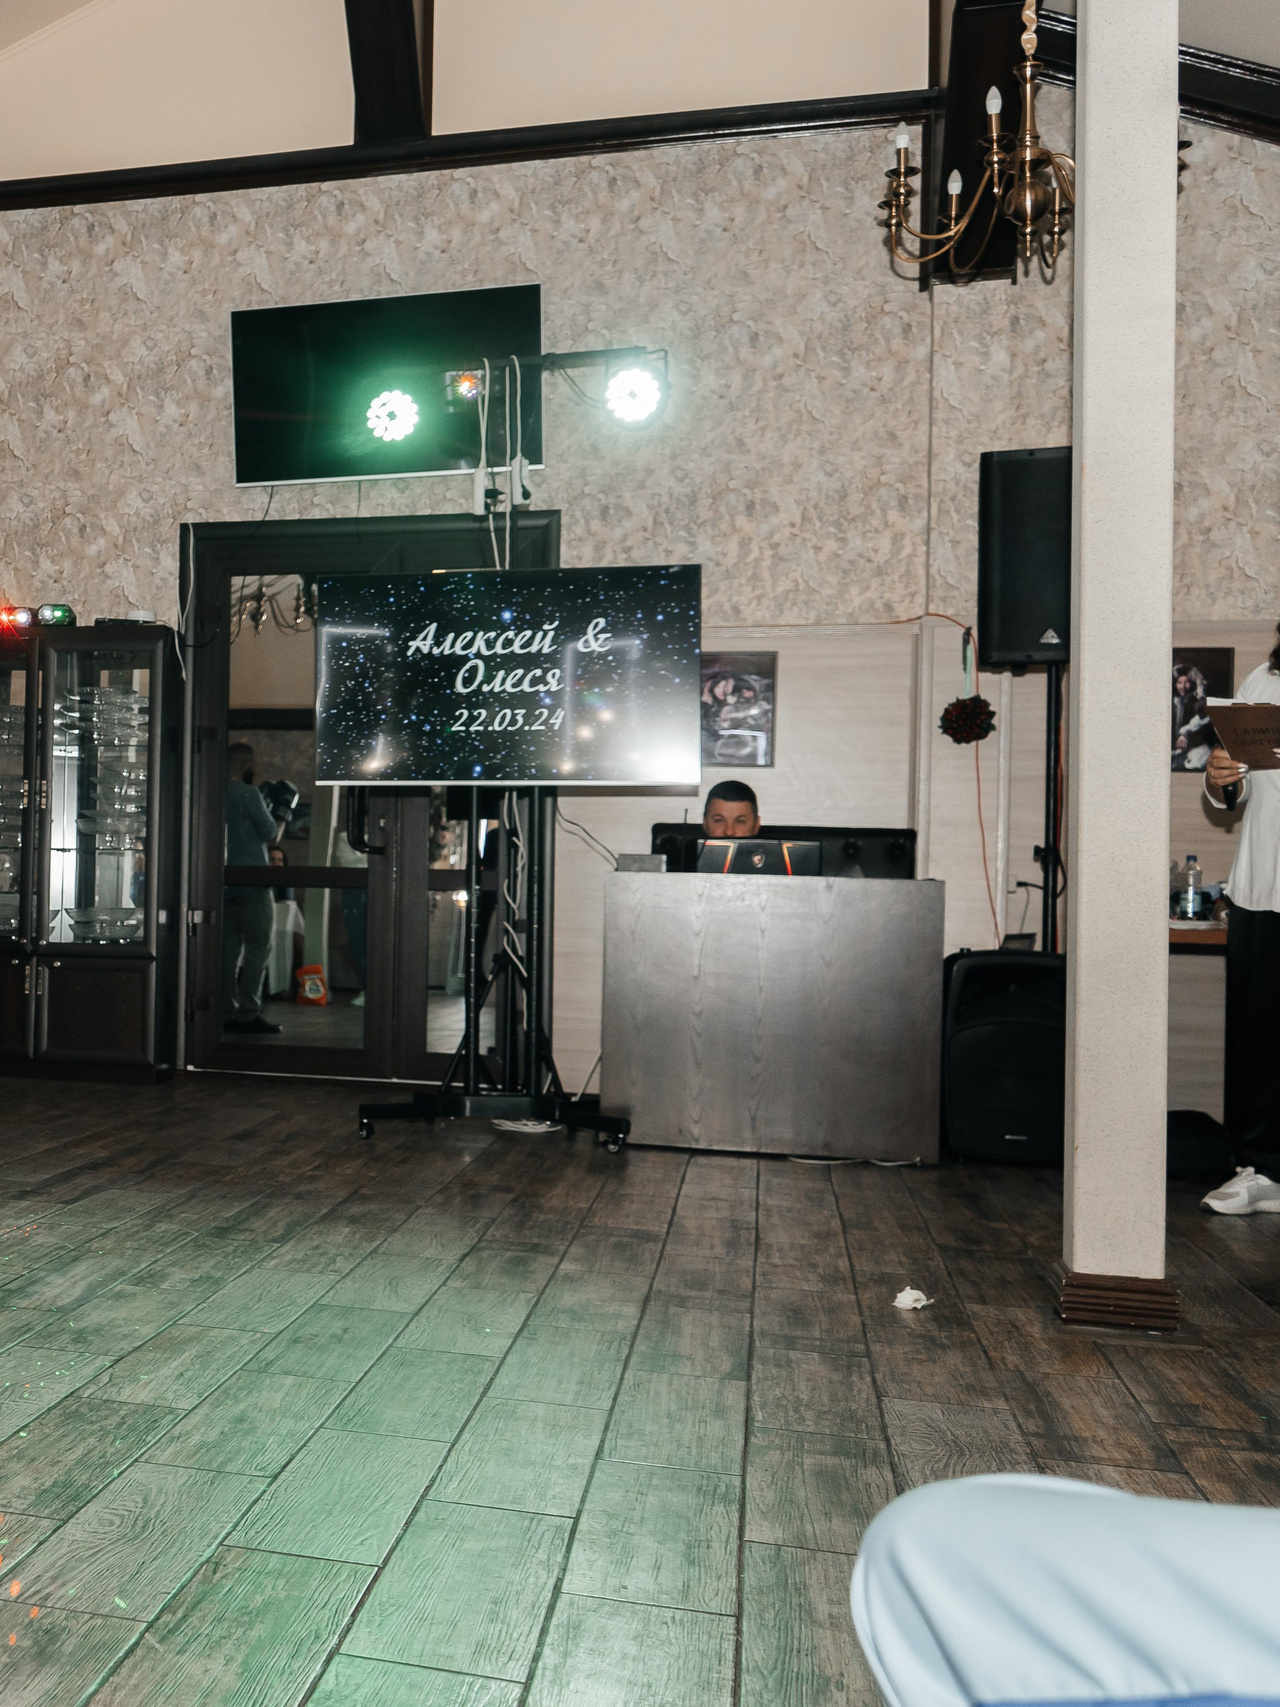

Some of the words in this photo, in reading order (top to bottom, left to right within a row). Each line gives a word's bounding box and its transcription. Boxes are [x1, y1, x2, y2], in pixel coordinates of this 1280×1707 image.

[407, 621, 559, 656] Алексей
[577, 617, 612, 653] &
[455, 659, 564, 693] Олеся
[451, 708, 565, 731] 22.03.24
